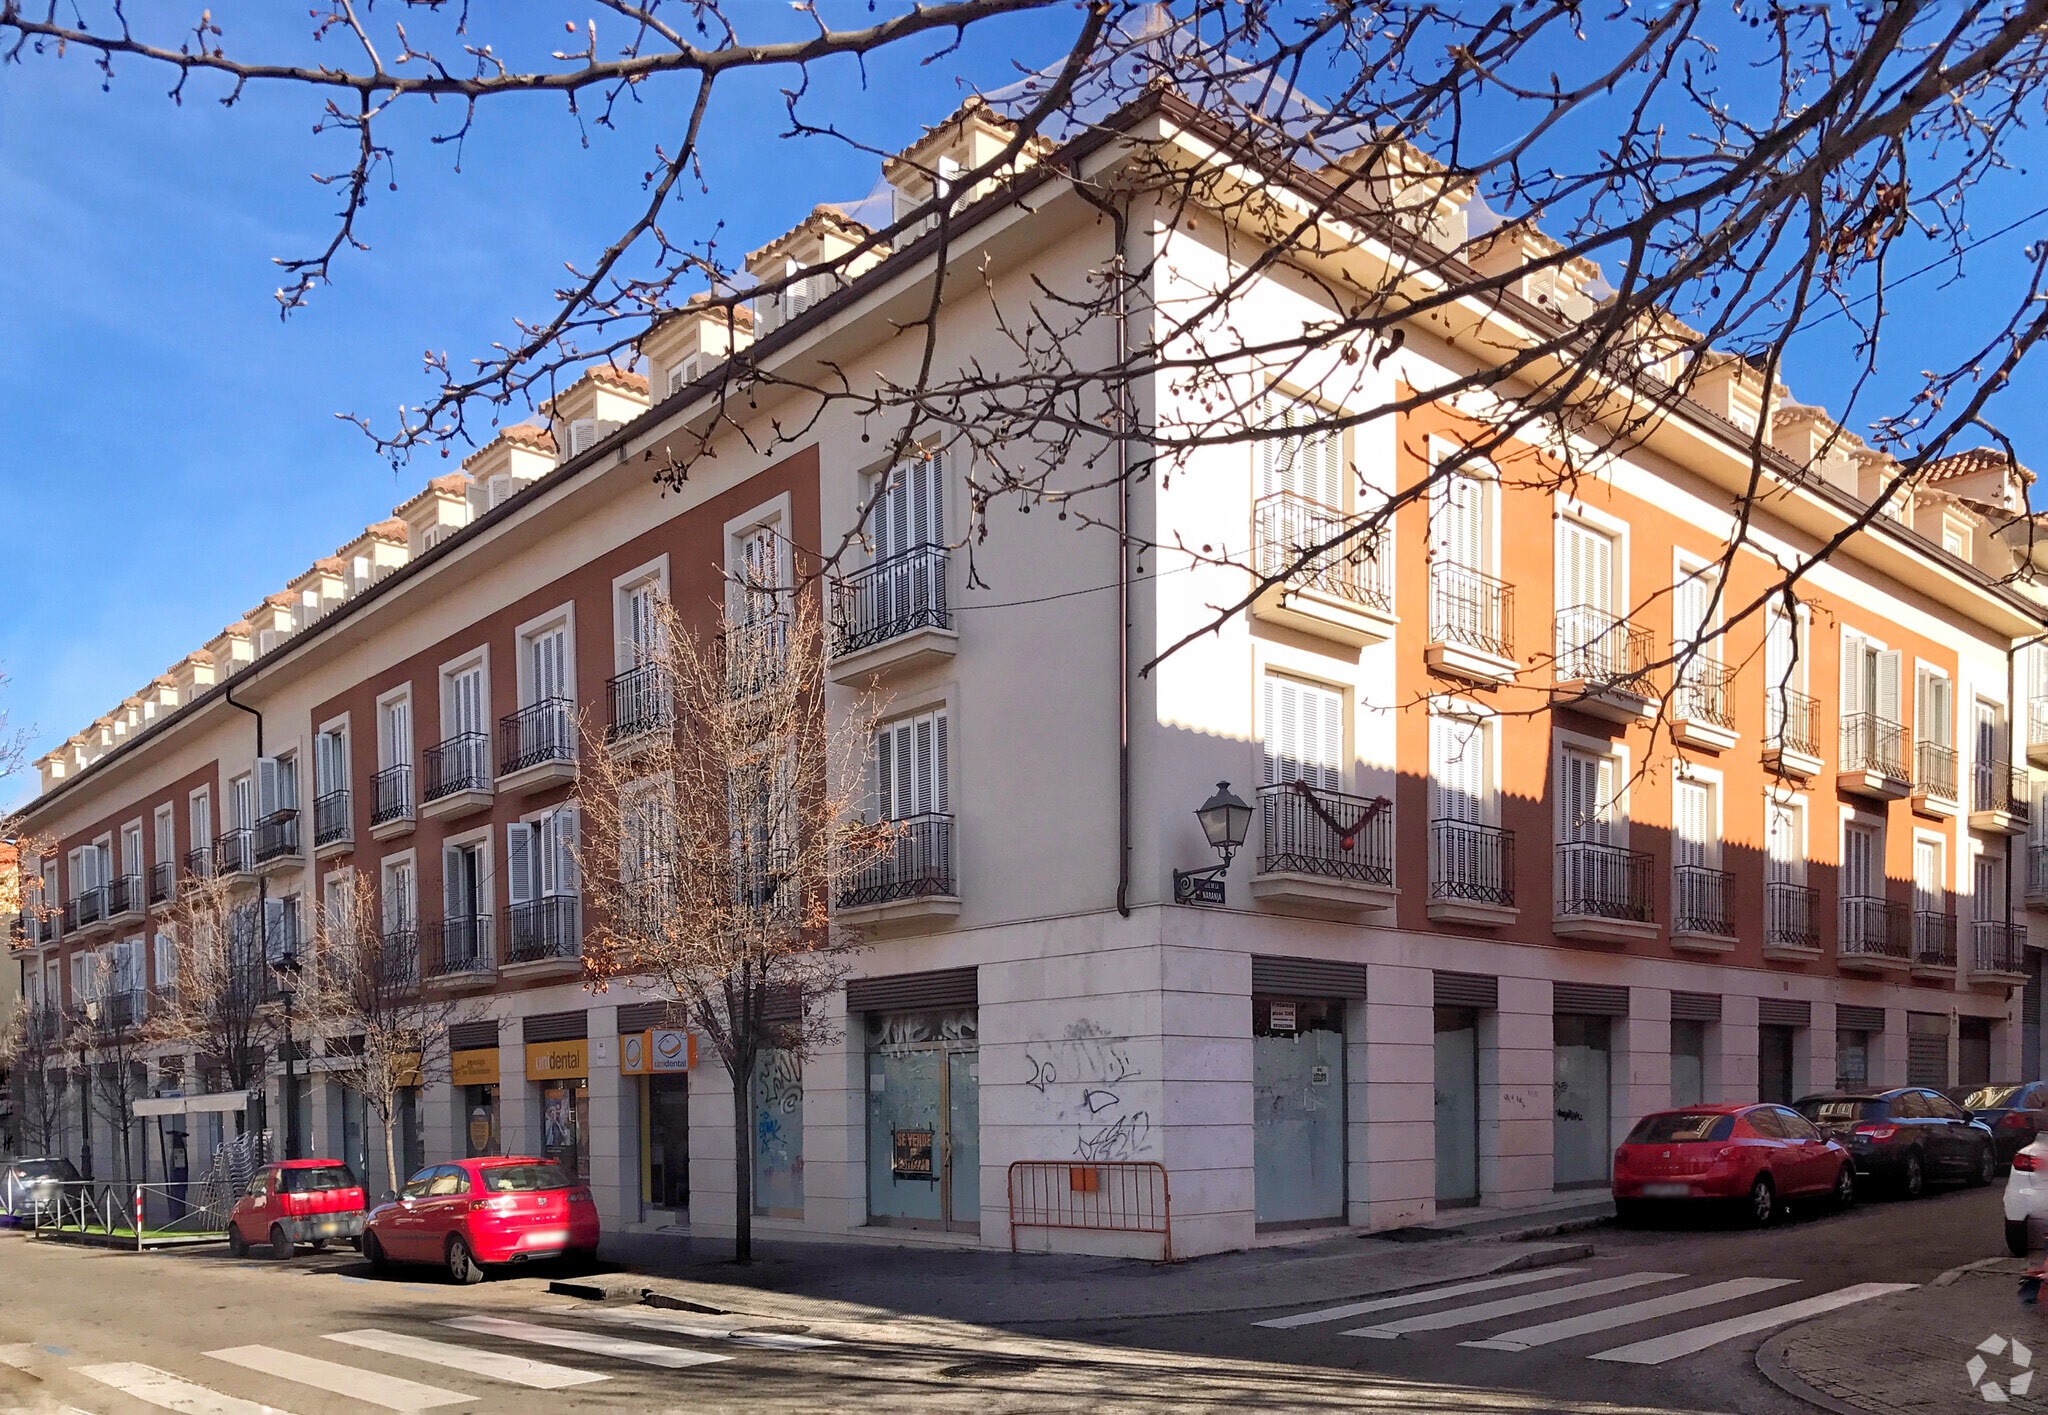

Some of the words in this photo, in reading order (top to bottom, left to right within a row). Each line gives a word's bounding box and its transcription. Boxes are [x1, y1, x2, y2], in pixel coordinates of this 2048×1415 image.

[535, 1049, 580, 1070] unidental
[654, 1059, 687, 1068] unidental
[897, 1133, 906, 1146] SE
[907, 1133, 931, 1147] VENDE
